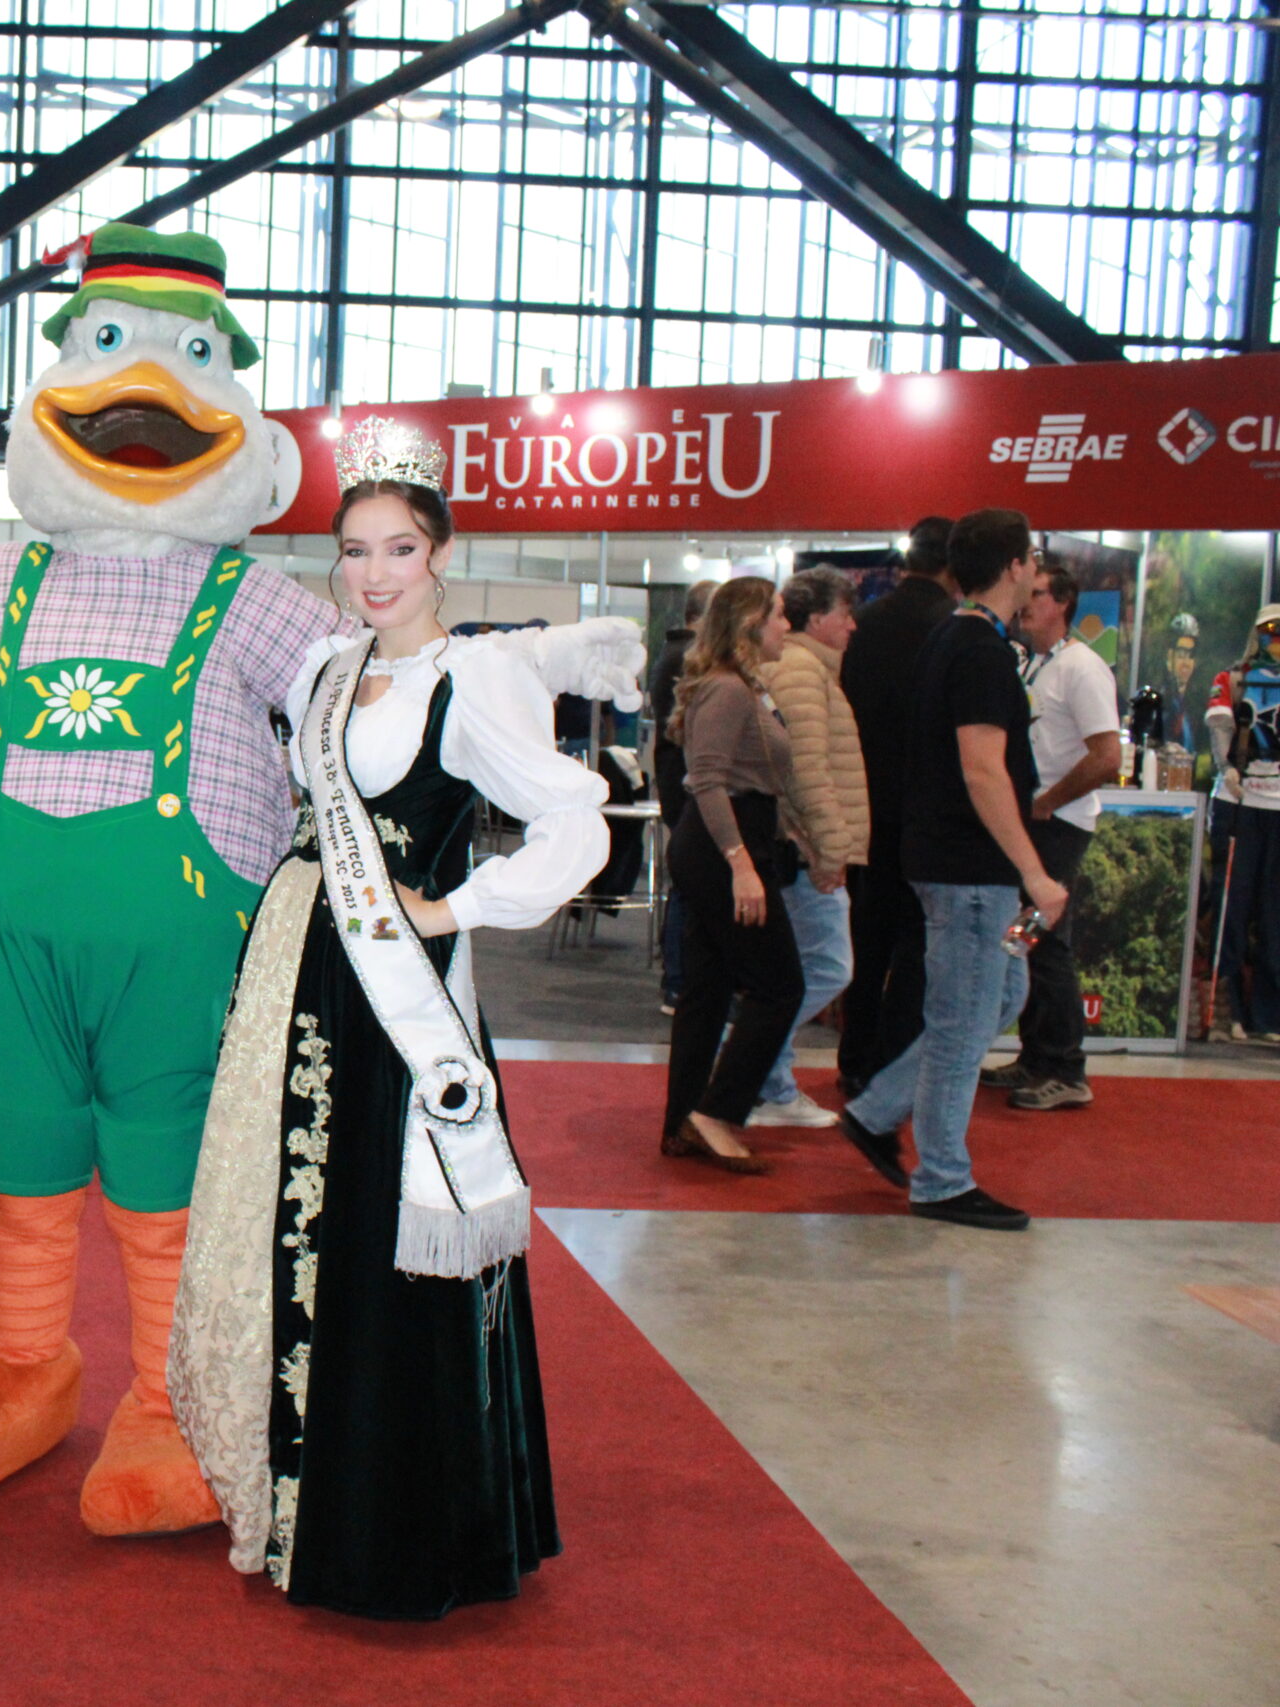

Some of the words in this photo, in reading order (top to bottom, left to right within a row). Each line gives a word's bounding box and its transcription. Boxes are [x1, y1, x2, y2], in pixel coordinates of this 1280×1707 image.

[1226, 415, 1280, 452] CI
[989, 434, 1127, 463] SEBRAE
[495, 494, 701, 510] CATARINENSE
[320, 687, 342, 755] Princesa
[330, 788, 366, 879] Fenarreco
[335, 860, 349, 875] SC
[341, 884, 358, 910] 2025
